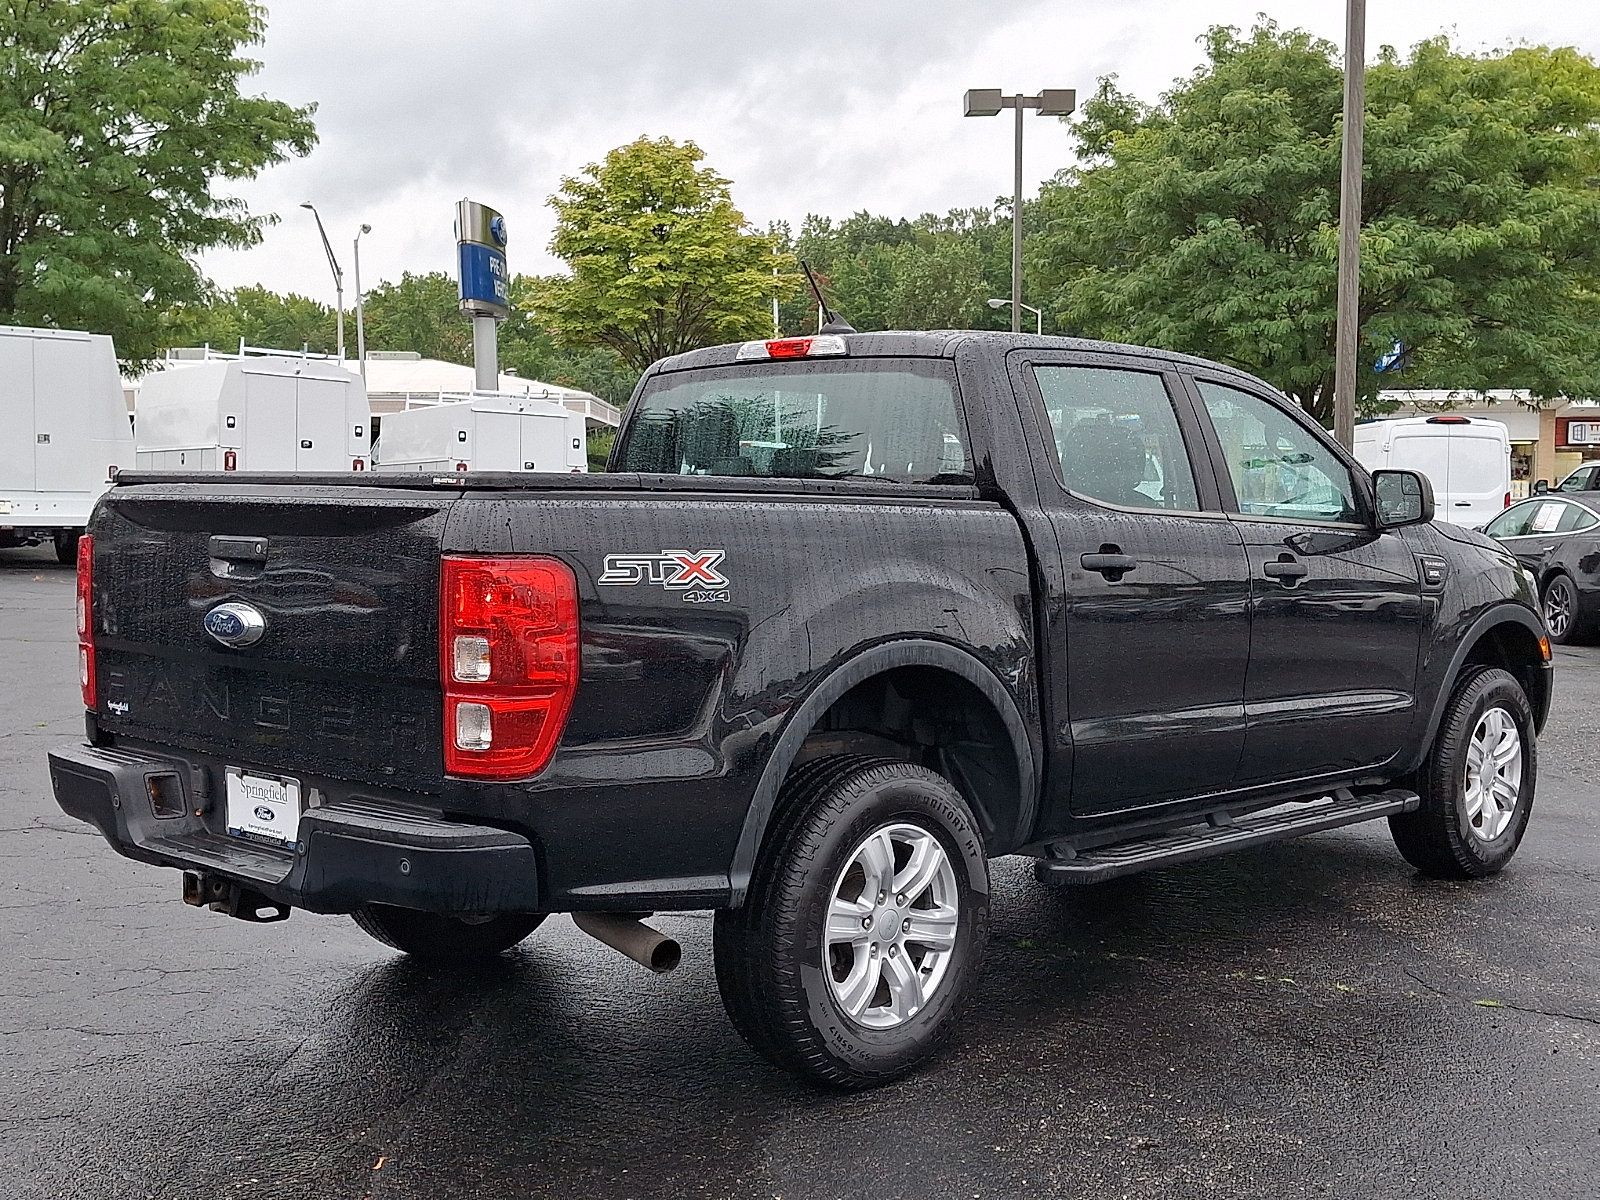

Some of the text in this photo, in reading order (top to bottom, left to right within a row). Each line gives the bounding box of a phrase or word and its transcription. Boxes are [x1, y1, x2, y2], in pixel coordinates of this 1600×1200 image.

[597, 549, 730, 590] STX
[210, 613, 236, 634] Ford
[240, 779, 288, 802] Springfield
[257, 806, 273, 820] Ford
[965, 839, 978, 858] HT
